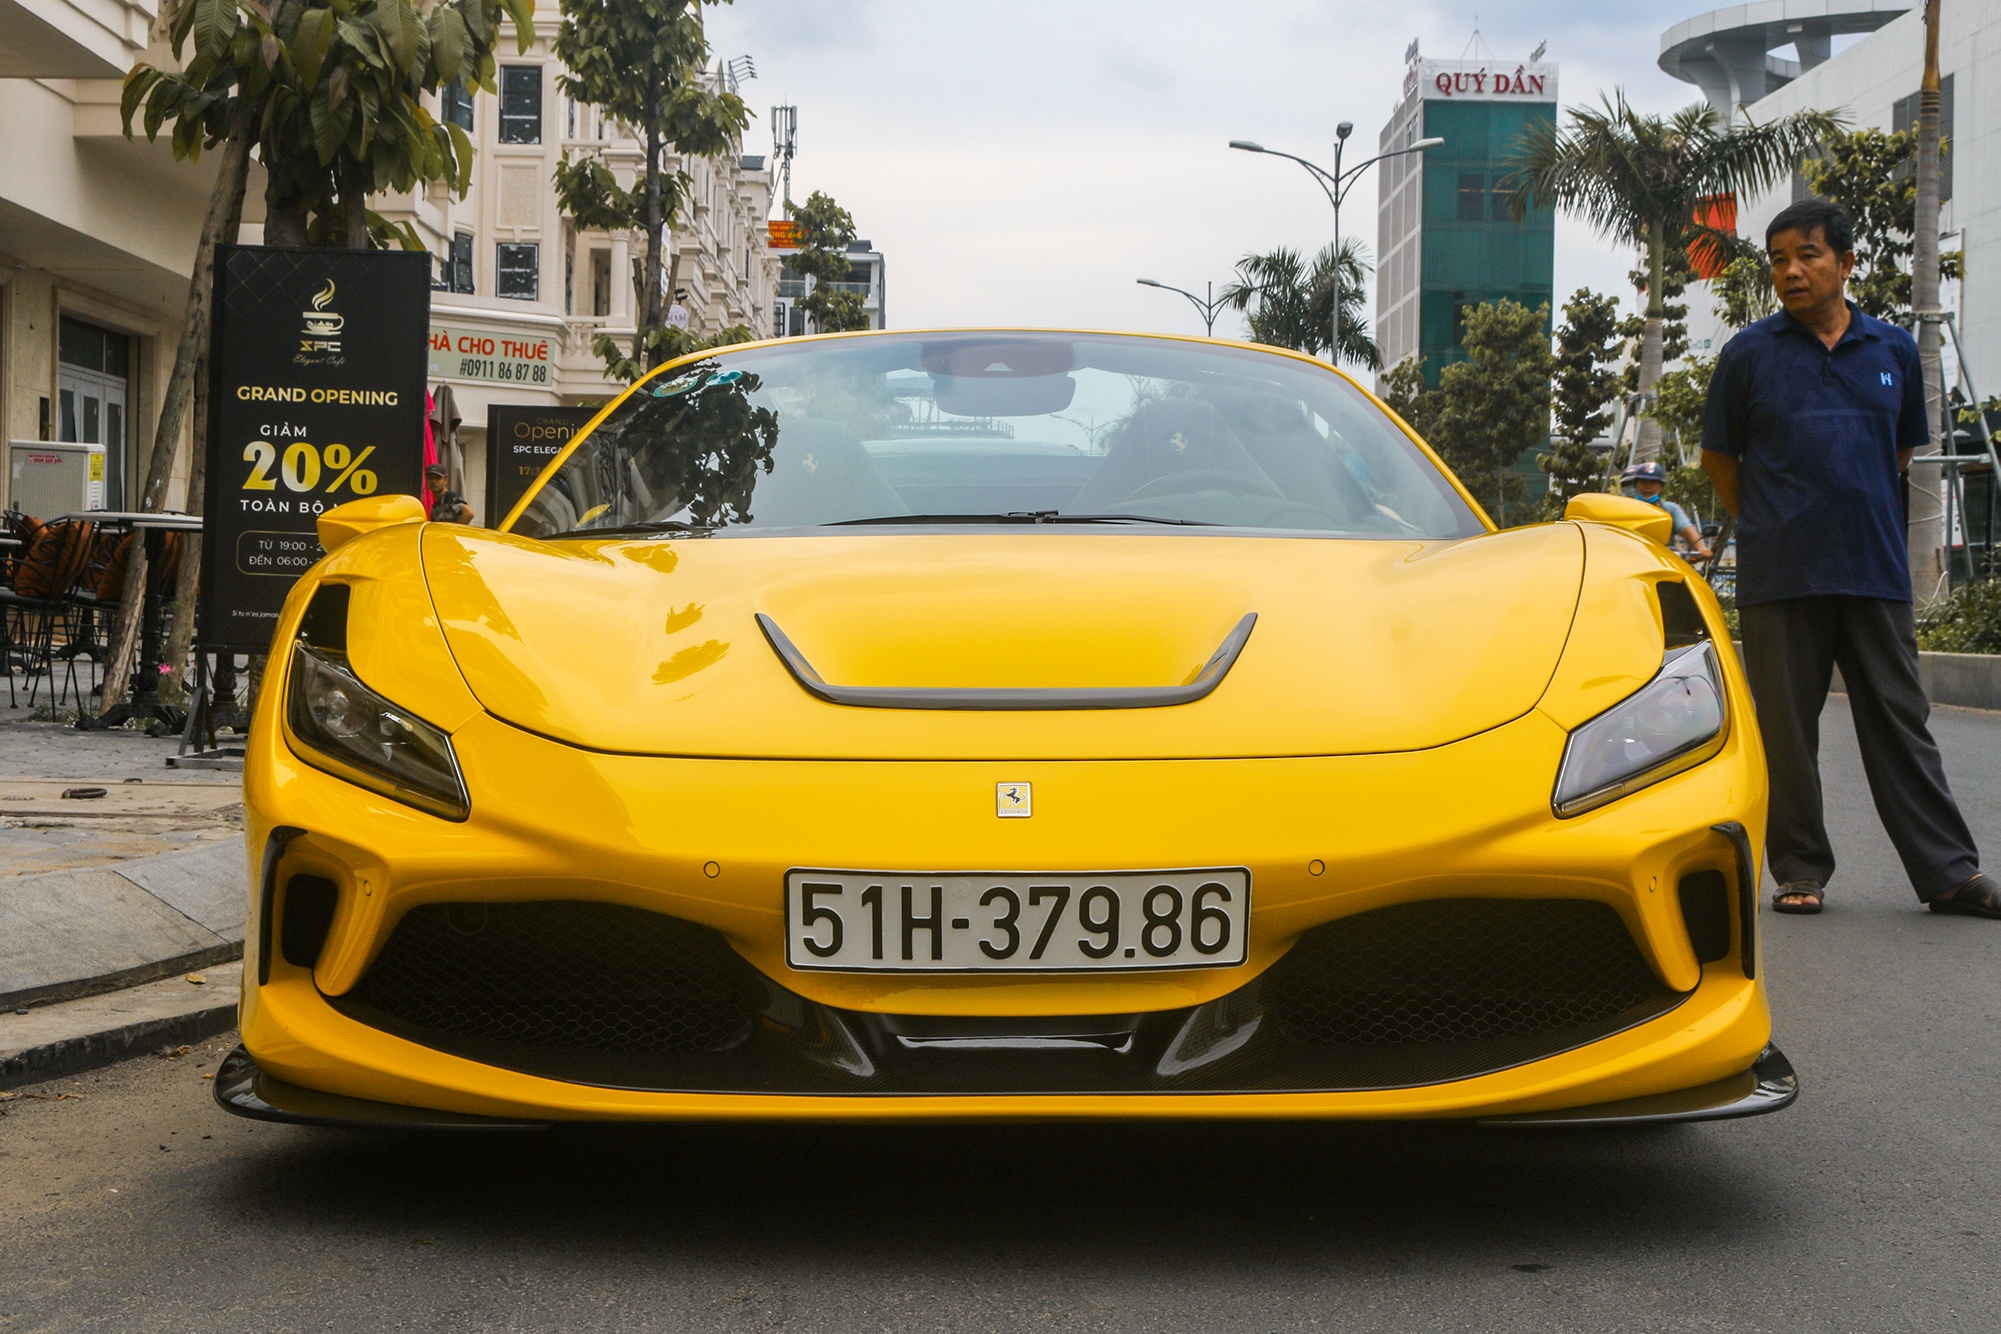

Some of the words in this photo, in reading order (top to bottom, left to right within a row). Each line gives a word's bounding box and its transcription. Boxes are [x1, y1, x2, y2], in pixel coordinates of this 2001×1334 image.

[1436, 67, 1487, 96] QUÝ
[1493, 65, 1545, 95] DẦN
[457, 336, 495, 355] CHO
[501, 340, 548, 361] THUÊ
[459, 358, 494, 378] #0911
[498, 362, 512, 380] 86
[515, 363, 529, 381] 87
[532, 365, 547, 383] 88
[237, 386, 306, 402] GRAND
[310, 389, 398, 406] OPENING
[260, 422, 307, 437] GIẢM
[536, 417, 569, 425] GRAND
[514, 421, 582, 442] Openi
[513, 445, 532, 454] SPC
[242, 441, 378, 495] 20%
[518, 465, 541, 476] 17:3
[240, 497, 290, 513] TOÀN
[299, 500, 324, 517] BỘ
[258, 539, 273, 550] TỪ
[279, 541, 307, 551] 19:00
[249, 554, 272, 566] ĐẾN
[277, 555, 307, 566] 06:00
[802, 882, 1232, 960] 51H-379.86
